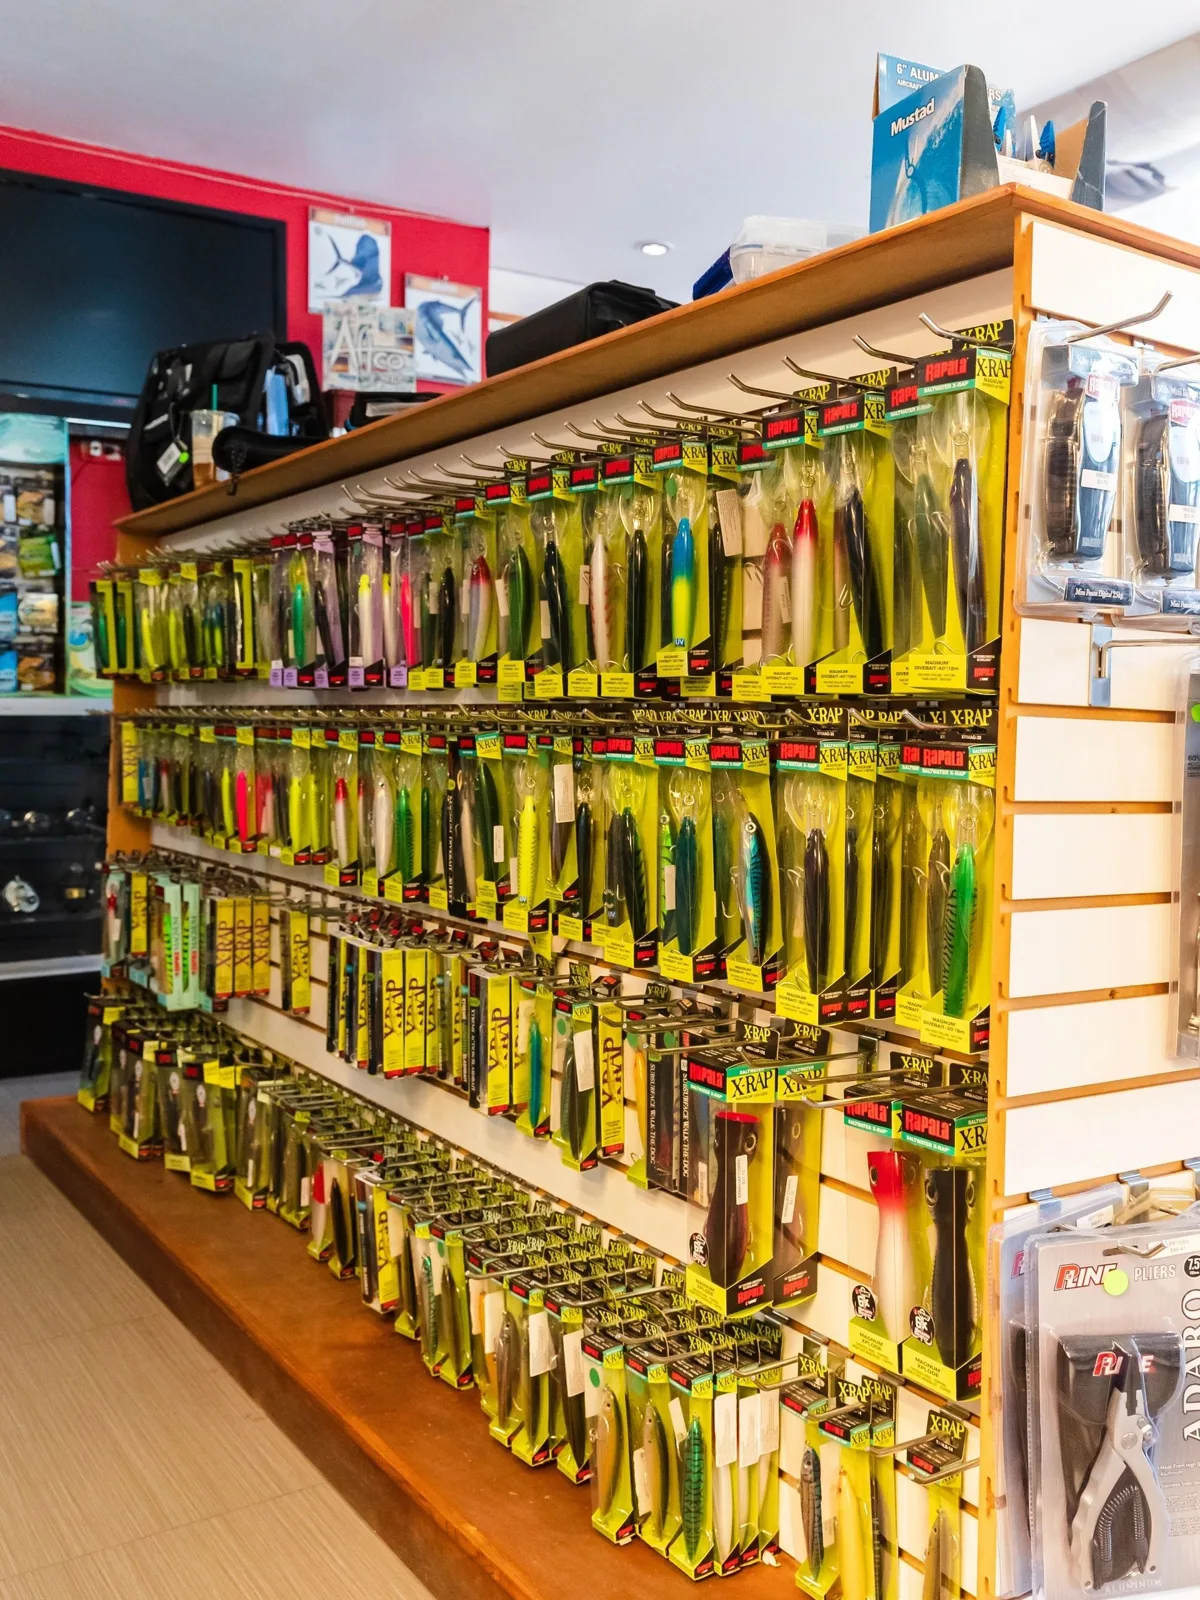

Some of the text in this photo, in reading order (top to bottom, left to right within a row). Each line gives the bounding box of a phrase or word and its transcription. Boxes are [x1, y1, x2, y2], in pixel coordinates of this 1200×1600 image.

[910, 66, 941, 82] ALUM
[890, 98, 935, 136] Mustad
[924, 380, 968, 394] SALTWATER X-RAP
[892, 386, 918, 408] Rapa
[865, 403, 884, 418] X-R
[713, 451, 738, 466] X-RA
[807, 708, 844, 724] X-RAP
[951, 708, 993, 726] X-RAP
[634, 742, 654, 754] X-RA
[685, 744, 708, 757] X-RA
[879, 751, 900, 767] X-RA
[743, 1024, 771, 1042] X-RAP
[793, 1023, 822, 1042] X-RAP
[901, 1056, 934, 1075] X-RAP
[731, 1070, 773, 1098] X-RAP
[961, 1068, 988, 1084] X-RA
[848, 1119, 872, 1132] SALTWATER
[968, 1116, 987, 1125] SALTWAT
[906, 1135, 949, 1152] SALTWATER X-RAP
[633, 1254, 655, 1269] X-RAP
[1134, 1264, 1176, 1282] PLIERS
[859, 1332, 884, 1346] MAGNUM
[862, 1339, 882, 1351] XPLODE
[915, 1357, 941, 1373] MAGNUM
[917, 1364, 939, 1378] XPLODE
[838, 1382, 870, 1402] X-RAP
[930, 1415, 965, 1439] X-RAP
